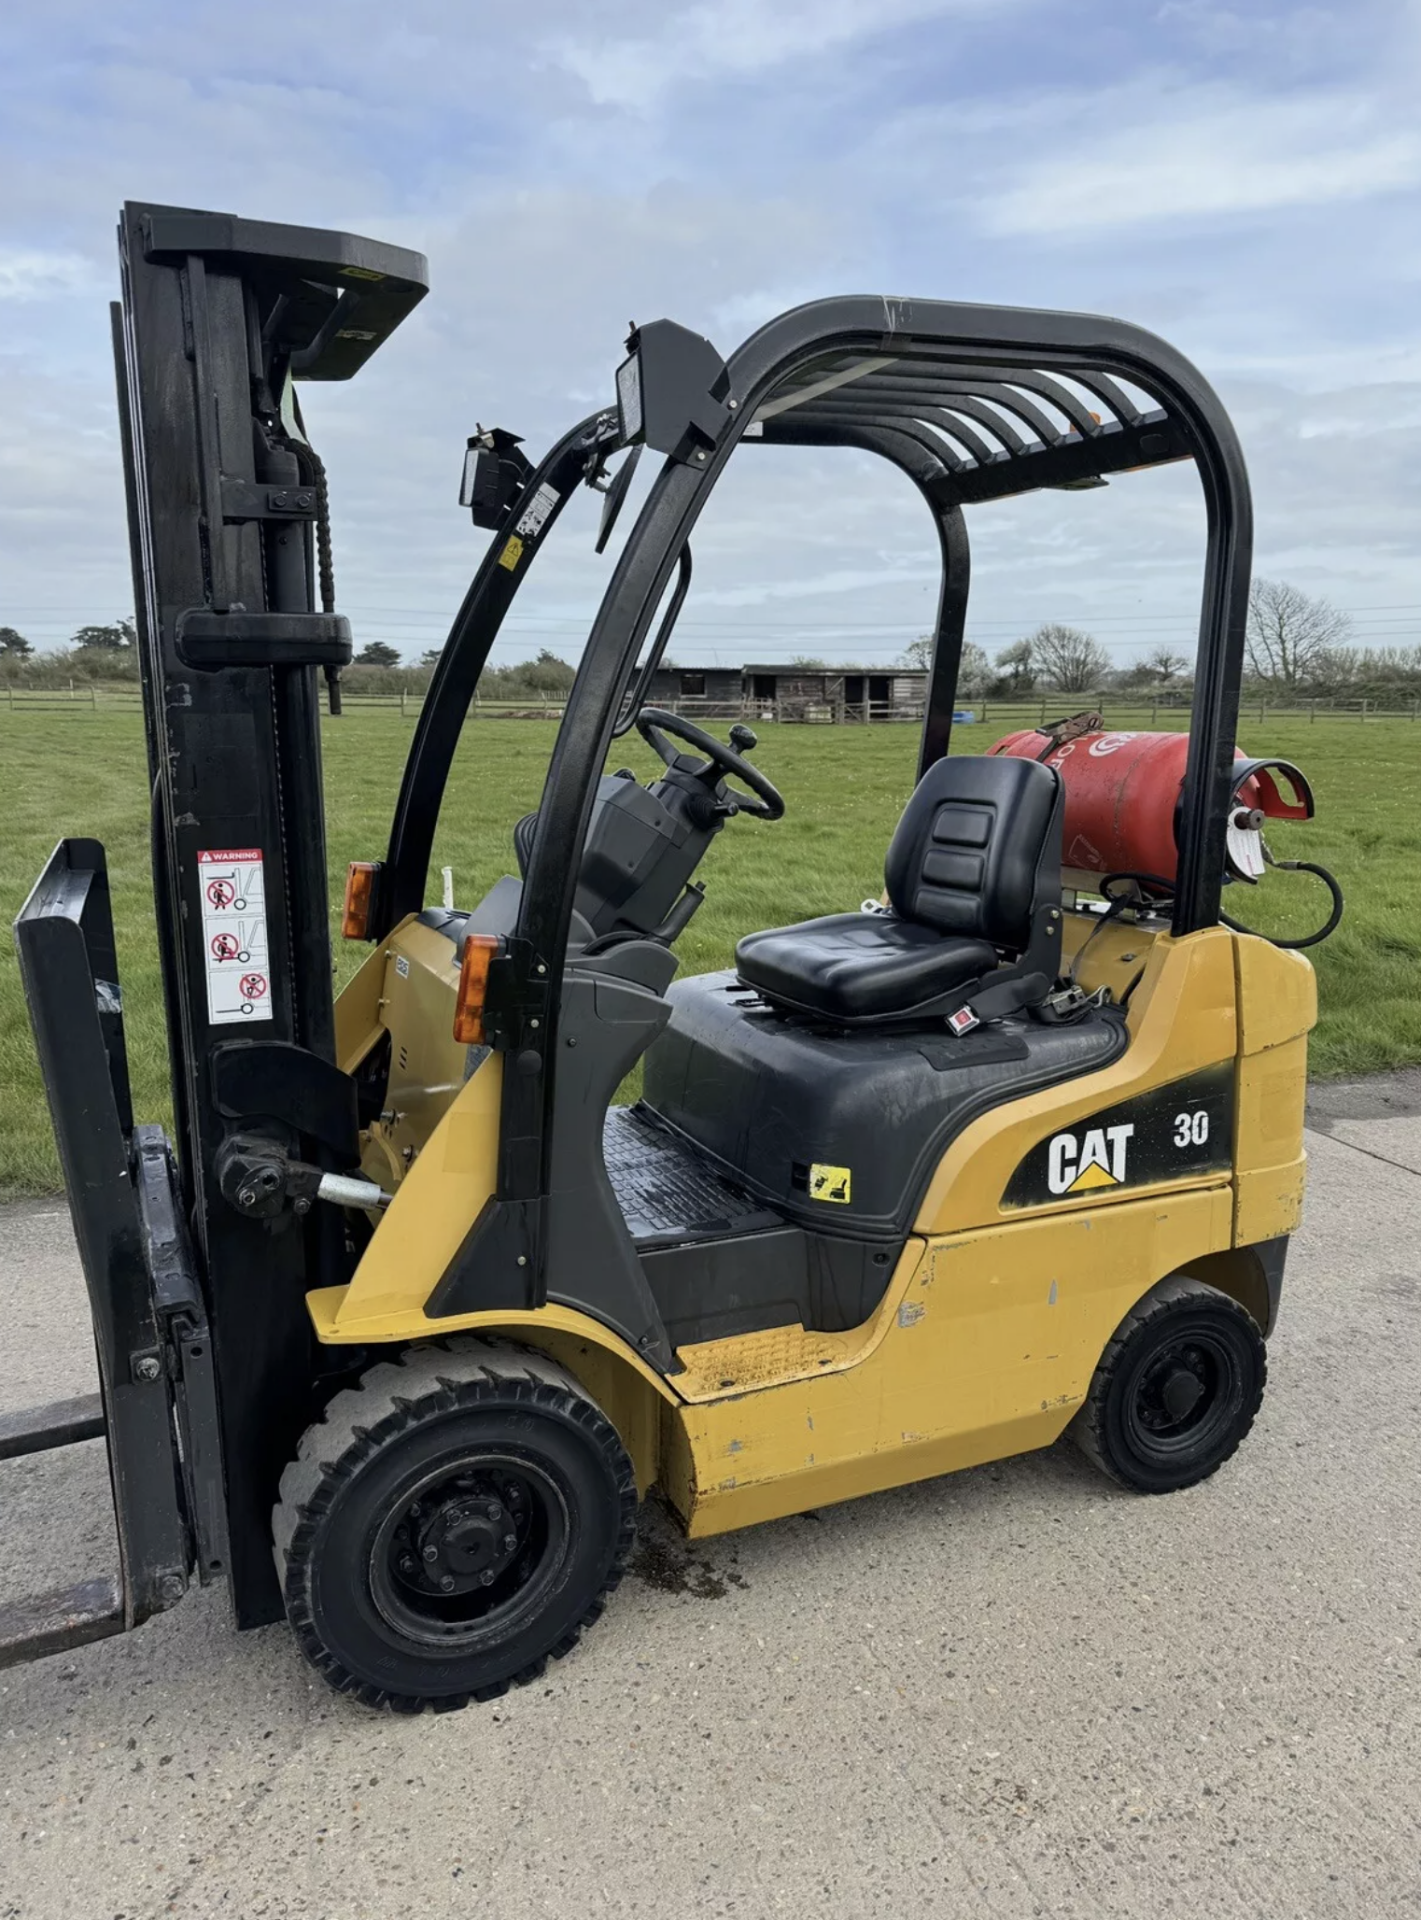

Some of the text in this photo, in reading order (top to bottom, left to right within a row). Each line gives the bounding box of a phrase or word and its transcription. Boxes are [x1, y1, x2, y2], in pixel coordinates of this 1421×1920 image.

[213, 852, 258, 860] WARNING
[1048, 1110, 1209, 1195] CAT 30
